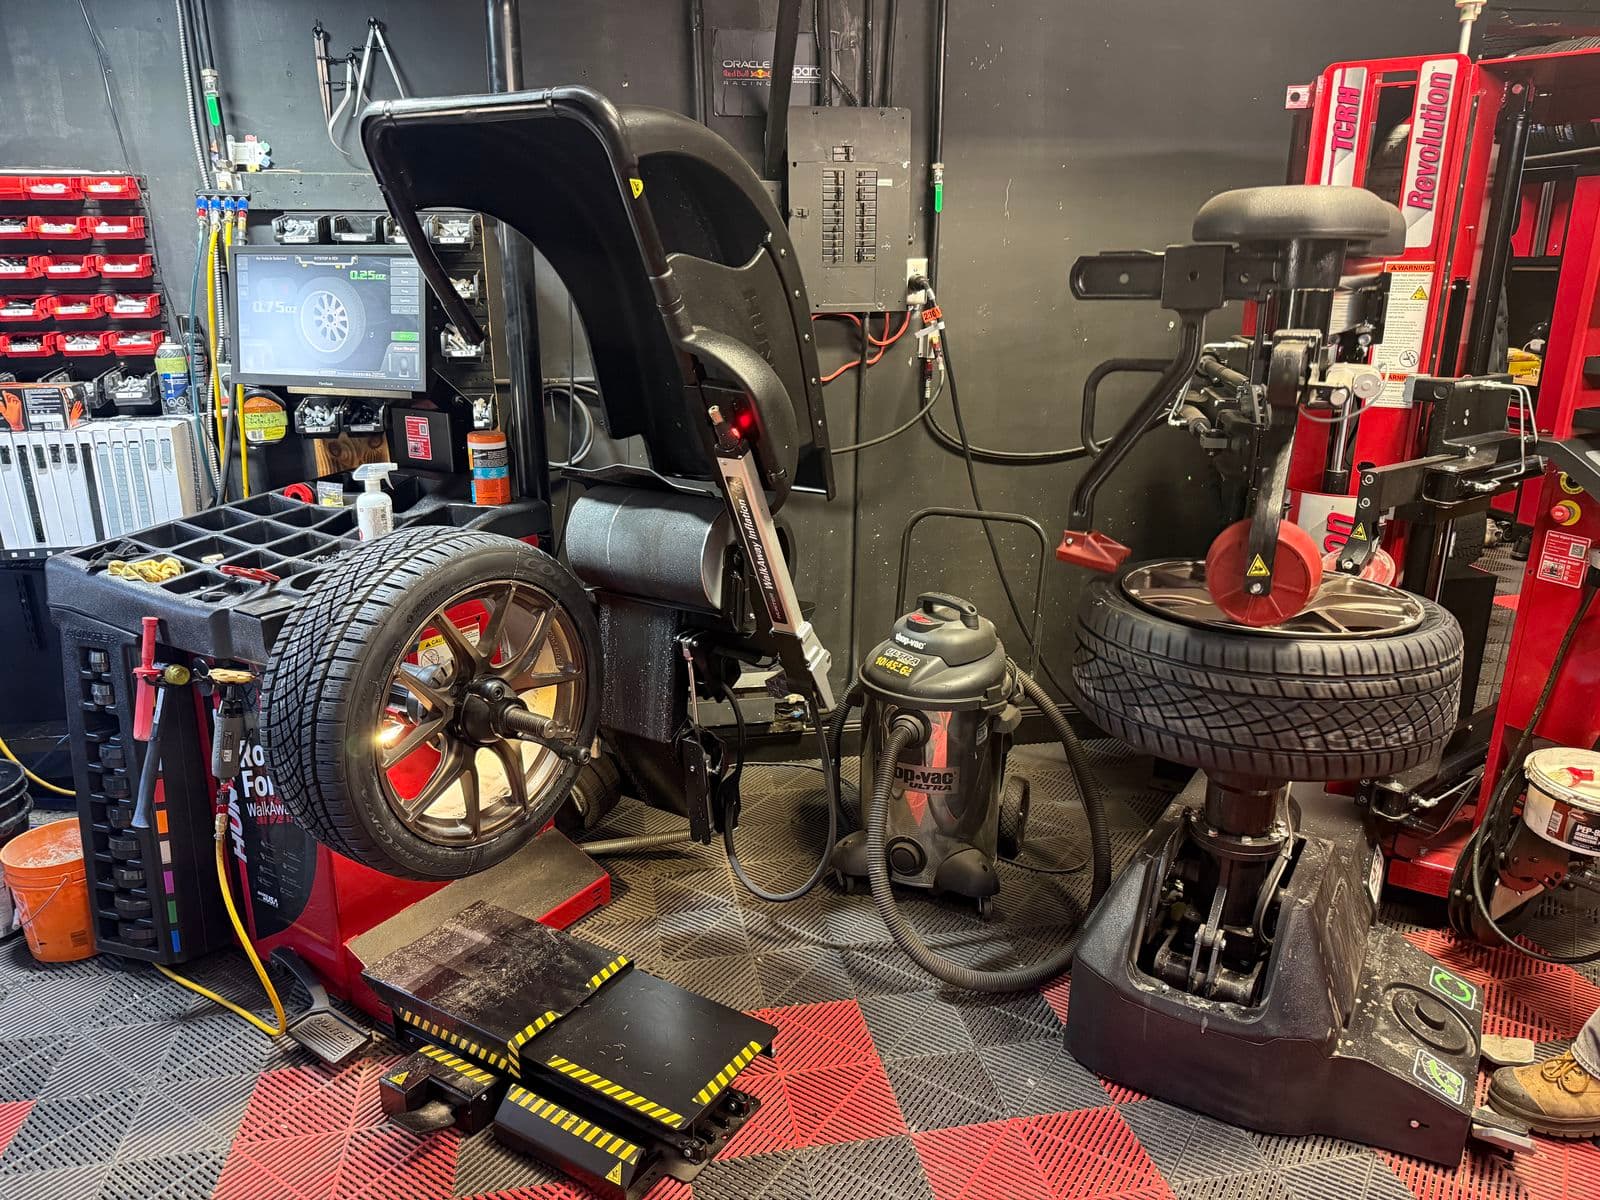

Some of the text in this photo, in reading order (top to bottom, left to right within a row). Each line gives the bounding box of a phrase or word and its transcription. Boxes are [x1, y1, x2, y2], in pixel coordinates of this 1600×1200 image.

[722, 60, 771, 69] ORACLE
[722, 69, 750, 78] Red Bull
[1332, 86, 1361, 151] TCRH
[1407, 72, 1453, 211] Revolution
[738, 498, 759, 541] Inflation
[750, 542, 775, 590] WalkAway
[884, 647, 920, 667] ULTRA
[909, 782, 952, 791] ULTRA
[247, 802, 290, 818] WalkAw
[1576, 824, 1600, 838] PEP-8
